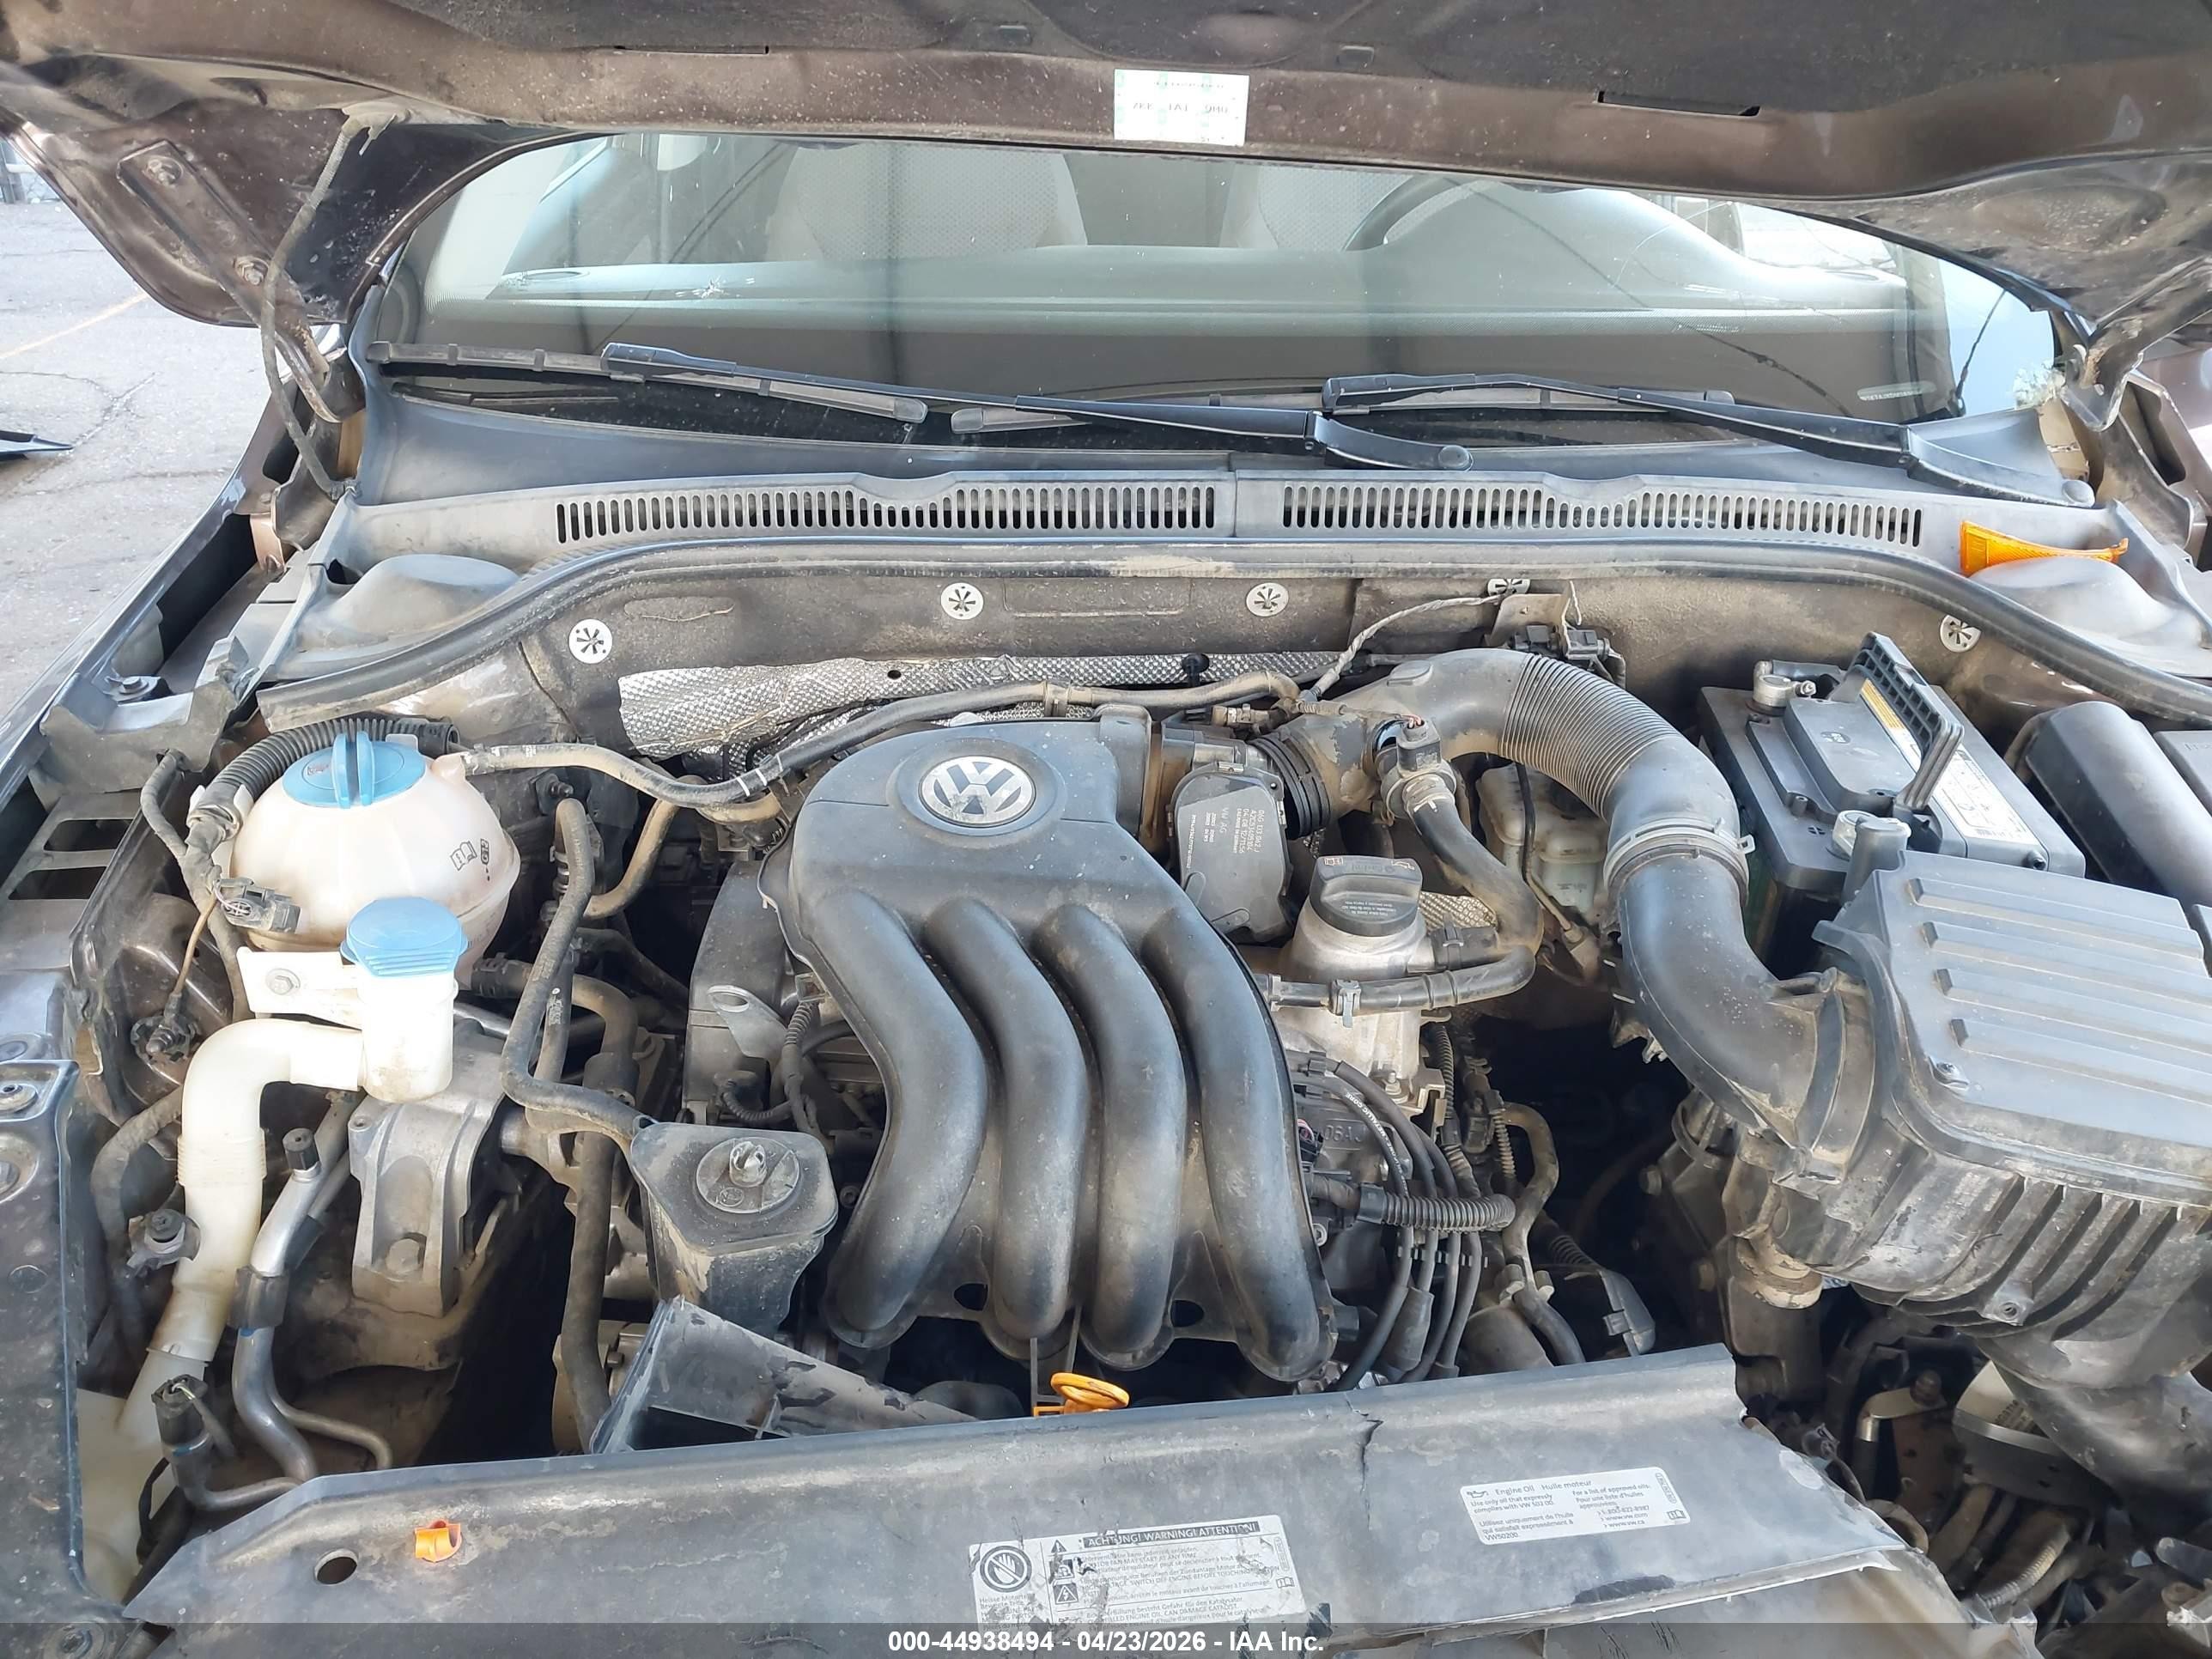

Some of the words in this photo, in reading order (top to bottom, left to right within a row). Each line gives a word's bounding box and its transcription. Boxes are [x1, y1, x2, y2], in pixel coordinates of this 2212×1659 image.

[1346, 1091, 1363, 1108] CORE
[1362, 1107, 1386, 1137] METALLIC
[1495, 1487, 1522, 1496] Engine
[1524, 1493, 1553, 1502] expressly
[1474, 1505, 1503, 1514] complies
[1144, 1528, 1197, 1540] WARNING!
[1126, 1613, 1150, 1621] ENGINE
